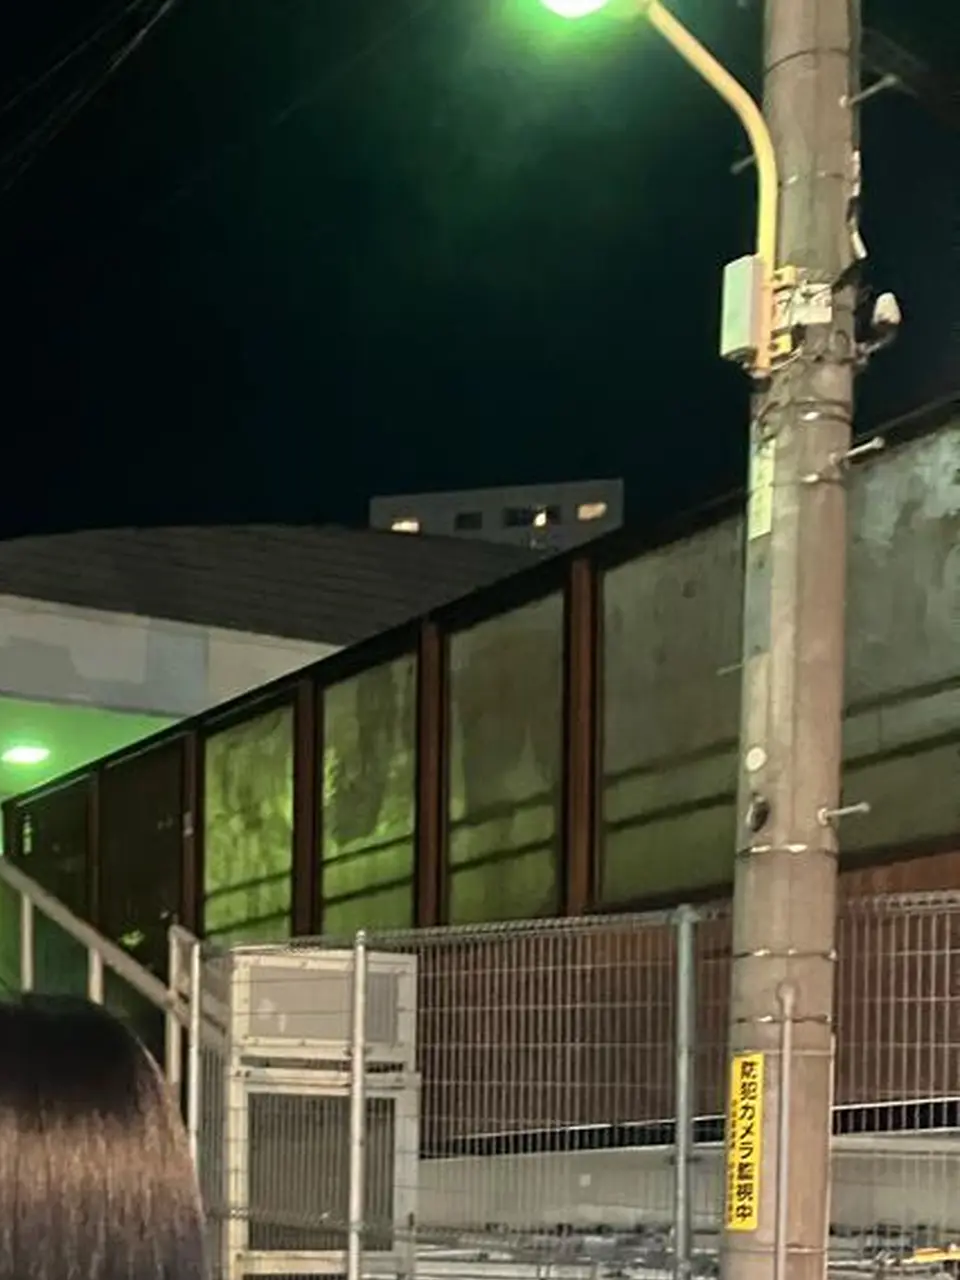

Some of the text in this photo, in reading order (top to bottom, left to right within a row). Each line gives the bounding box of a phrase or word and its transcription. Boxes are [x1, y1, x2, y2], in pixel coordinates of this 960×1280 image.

[736, 1060, 758, 1222] 防犯カメラ監視中
